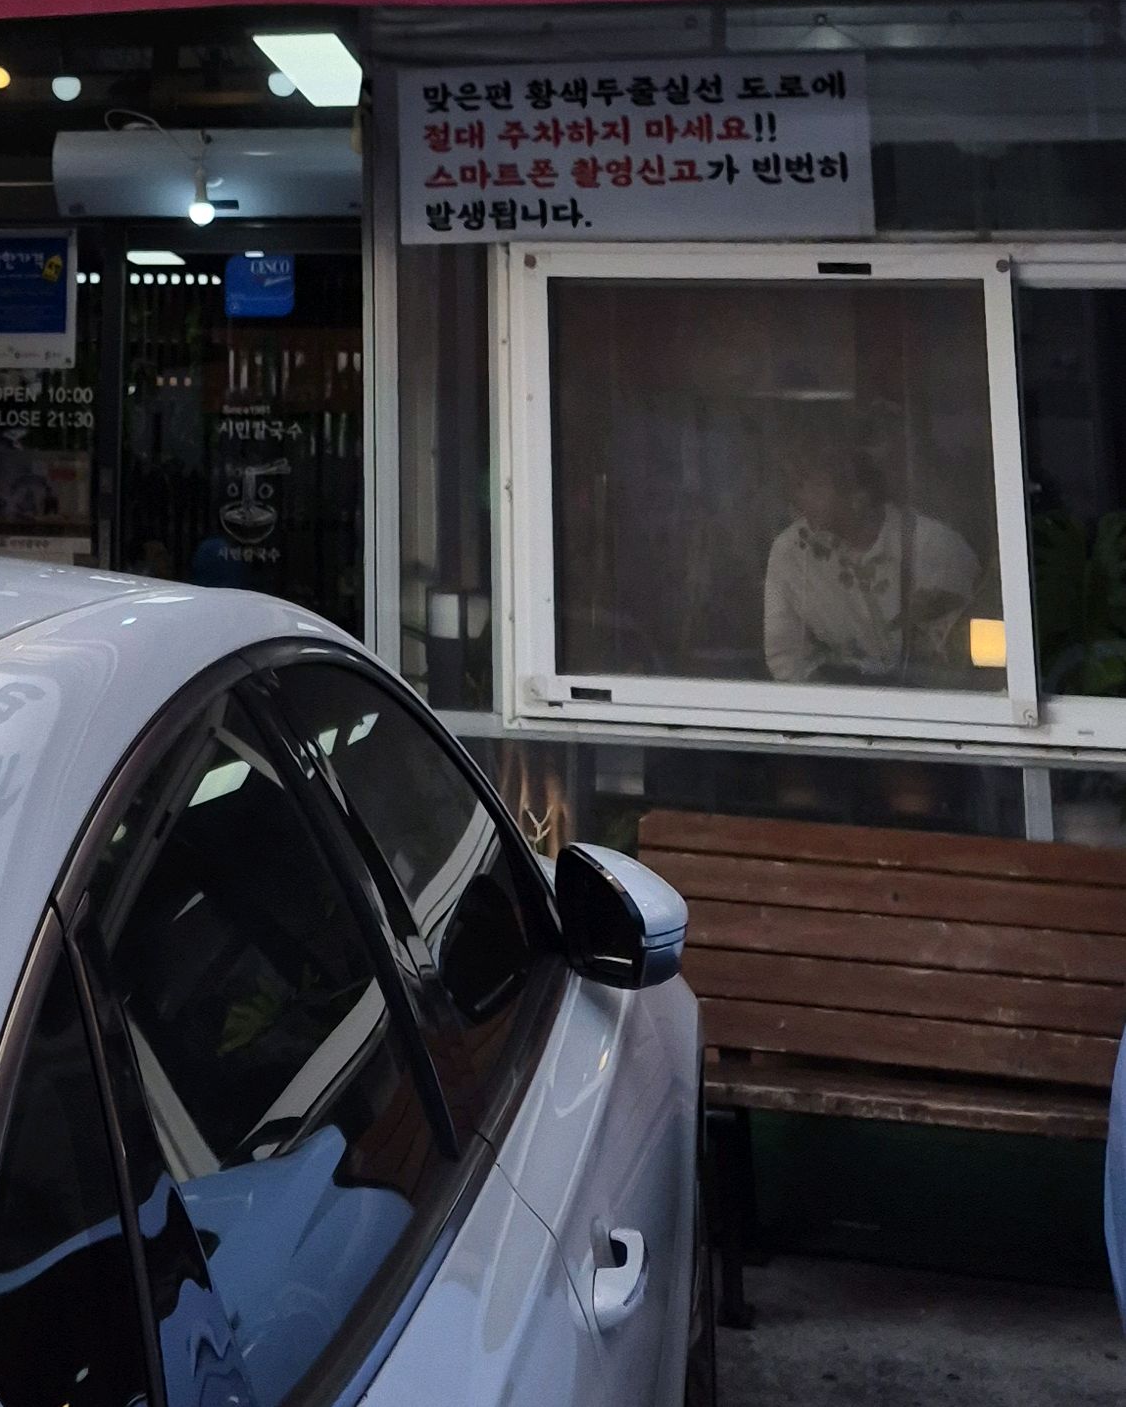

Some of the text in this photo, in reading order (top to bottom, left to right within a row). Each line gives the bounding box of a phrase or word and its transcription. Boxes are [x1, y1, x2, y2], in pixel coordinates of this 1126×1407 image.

[422, 70, 847, 113] 맞은편 황색두줄실선 도로에
[423, 113, 777, 153] 절대 주차하지 마세요!!
[424, 151, 848, 190] 스마트폰 촬영신고가 빈번히
[424, 198, 593, 232] 발생됩니다.
[47, 386, 94, 405] 10:00
[47, 410, 94, 428] 21:30
